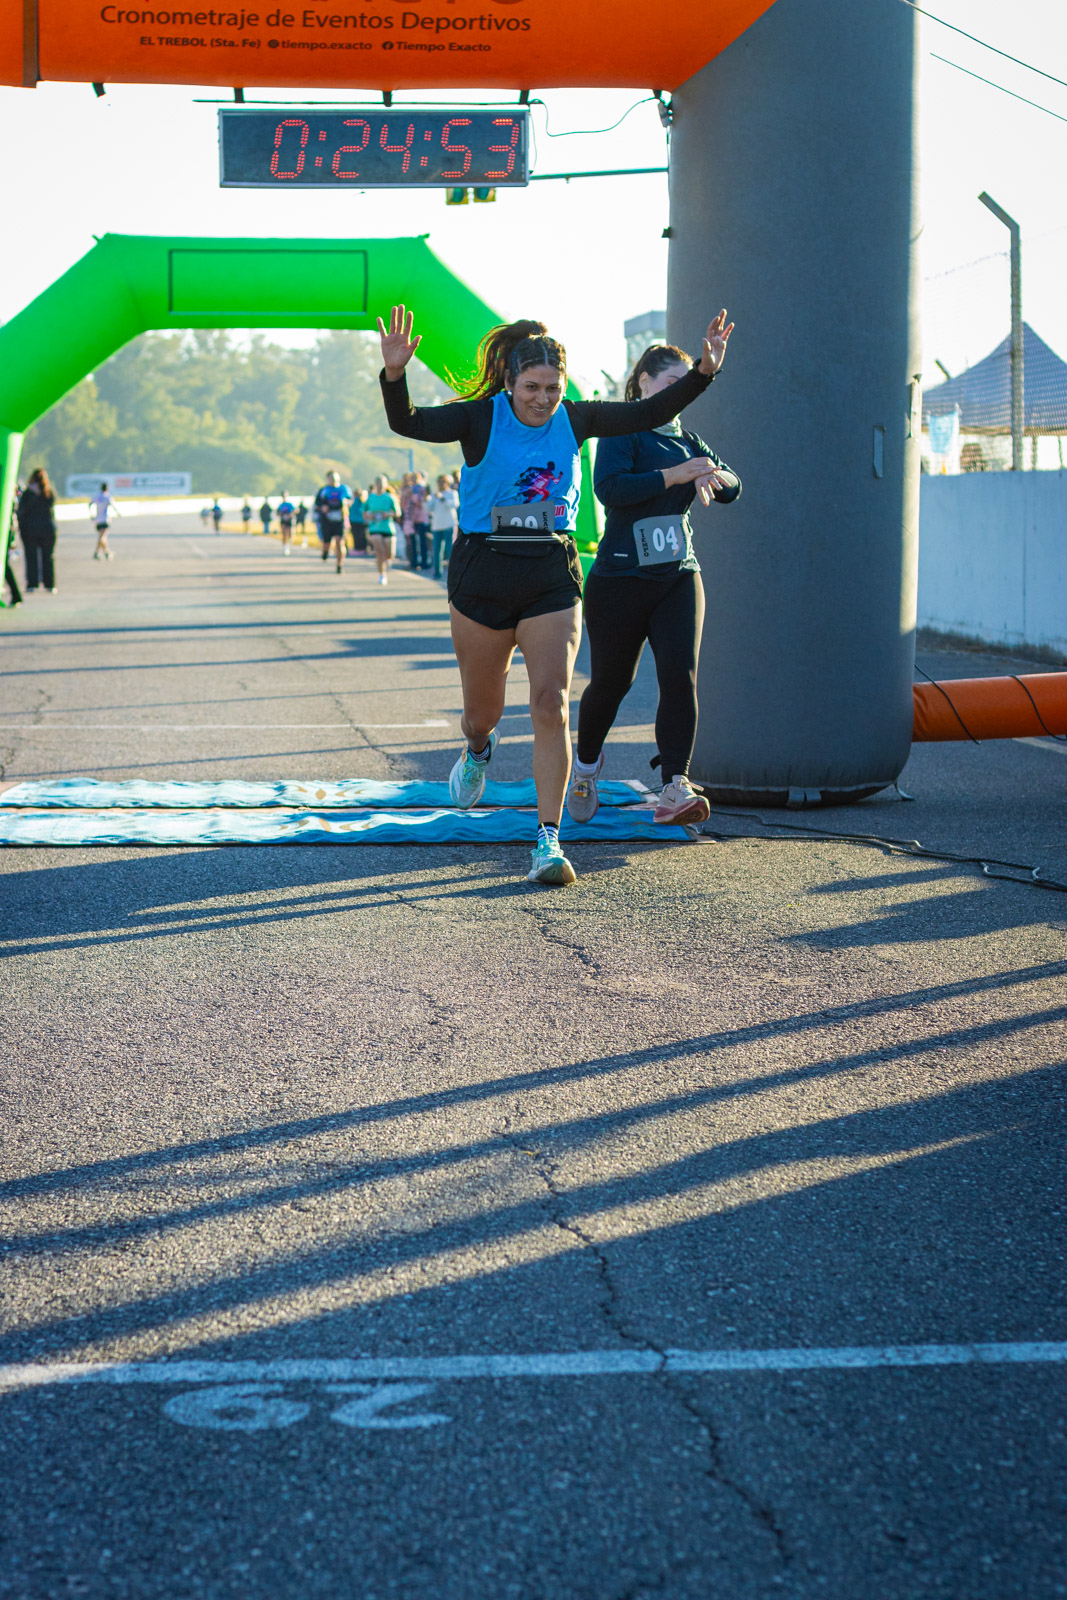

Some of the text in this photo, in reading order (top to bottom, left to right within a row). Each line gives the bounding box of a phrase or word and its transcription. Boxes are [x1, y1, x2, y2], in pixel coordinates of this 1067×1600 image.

[100, 5, 531, 34] Cronometraje de Eventos Deportivos
[140, 36, 491, 53] EL TREBOL (Sta. Fe) tiempo.exacto Tiempo Exacto
[270, 118, 520, 179] 0:24:53
[652, 526, 679, 552] 04
